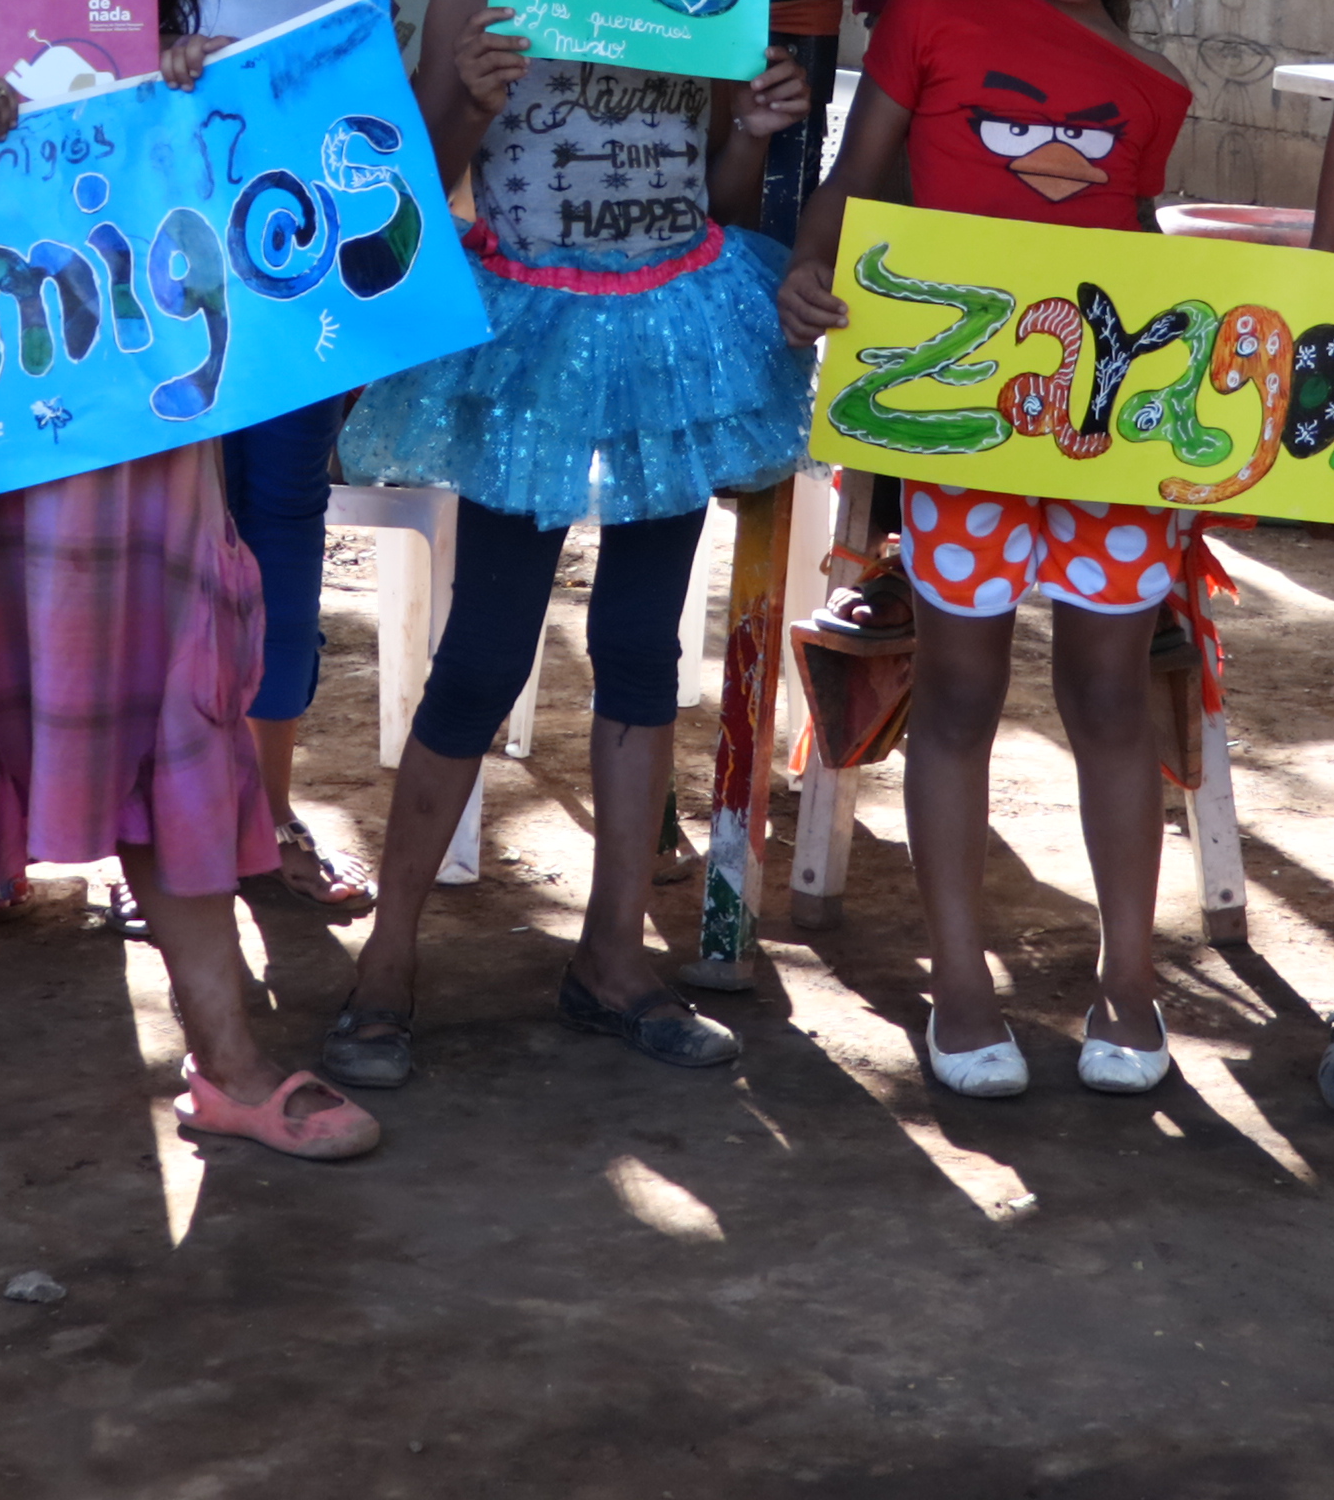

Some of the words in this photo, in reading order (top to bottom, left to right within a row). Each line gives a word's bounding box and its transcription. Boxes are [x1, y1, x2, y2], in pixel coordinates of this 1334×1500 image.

[89, 6, 130, 21] nada
[588, 12, 692, 40] queremos
[611, 144, 661, 169] CAN
